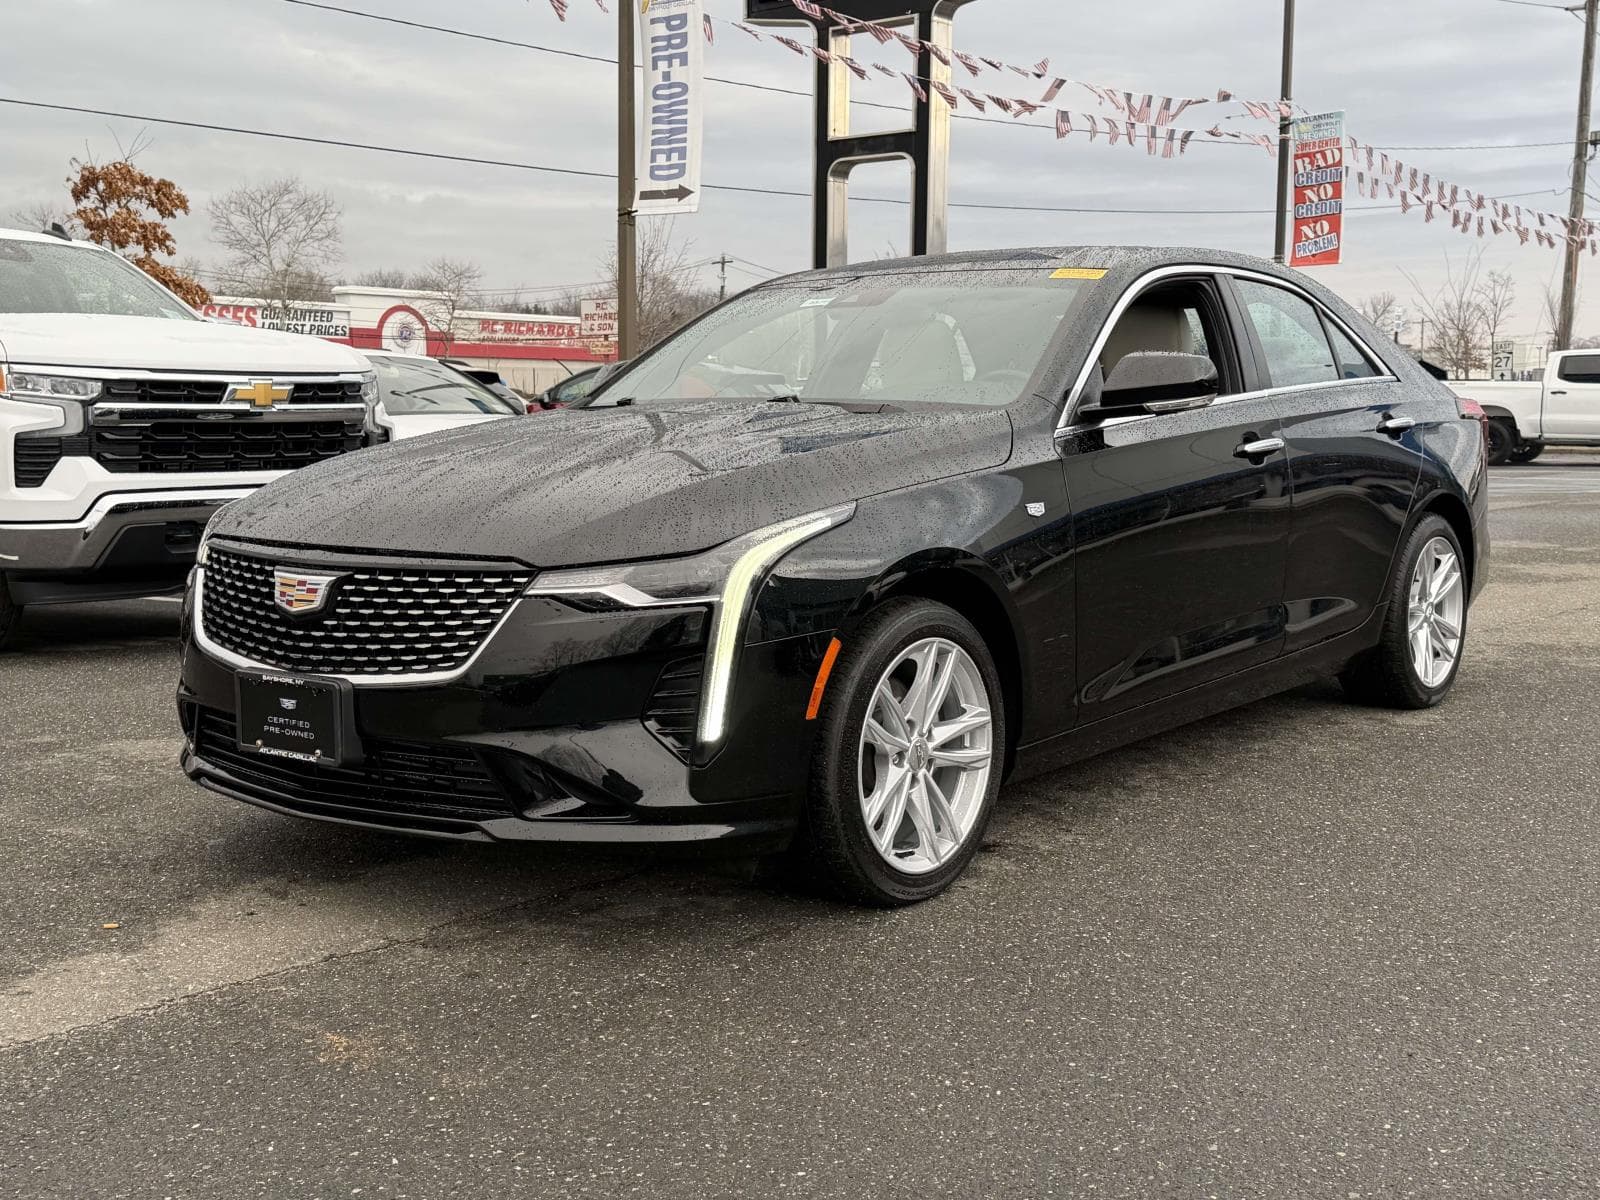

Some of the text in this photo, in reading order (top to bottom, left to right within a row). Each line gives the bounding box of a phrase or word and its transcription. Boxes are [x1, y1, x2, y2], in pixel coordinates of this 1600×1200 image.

[650, 13, 689, 181] PRE-OWNED
[1300, 112, 1334, 123] ATLANTIC
[1296, 137, 1340, 152] SUPER CENTER
[1294, 148, 1341, 174] BAD
[1295, 168, 1341, 187] CREDIT
[1303, 183, 1334, 204] NO
[1295, 201, 1341, 219] CREDIT
[1300, 220, 1330, 241] NO
[1296, 234, 1338, 257] PROBLEM!
[261, 307, 334, 322] GUARANTEED
[309, 325, 347, 337] PRICES
[503, 321, 566, 337] RICHARD
[589, 323, 614, 332] & SON
[1495, 356, 1510, 368] 27
[268, 716, 310, 728] CERTIFIED
[264, 725, 315, 739] PRE-OWNED
[259, 747, 317, 762] ATLANTIC CADILLAC
